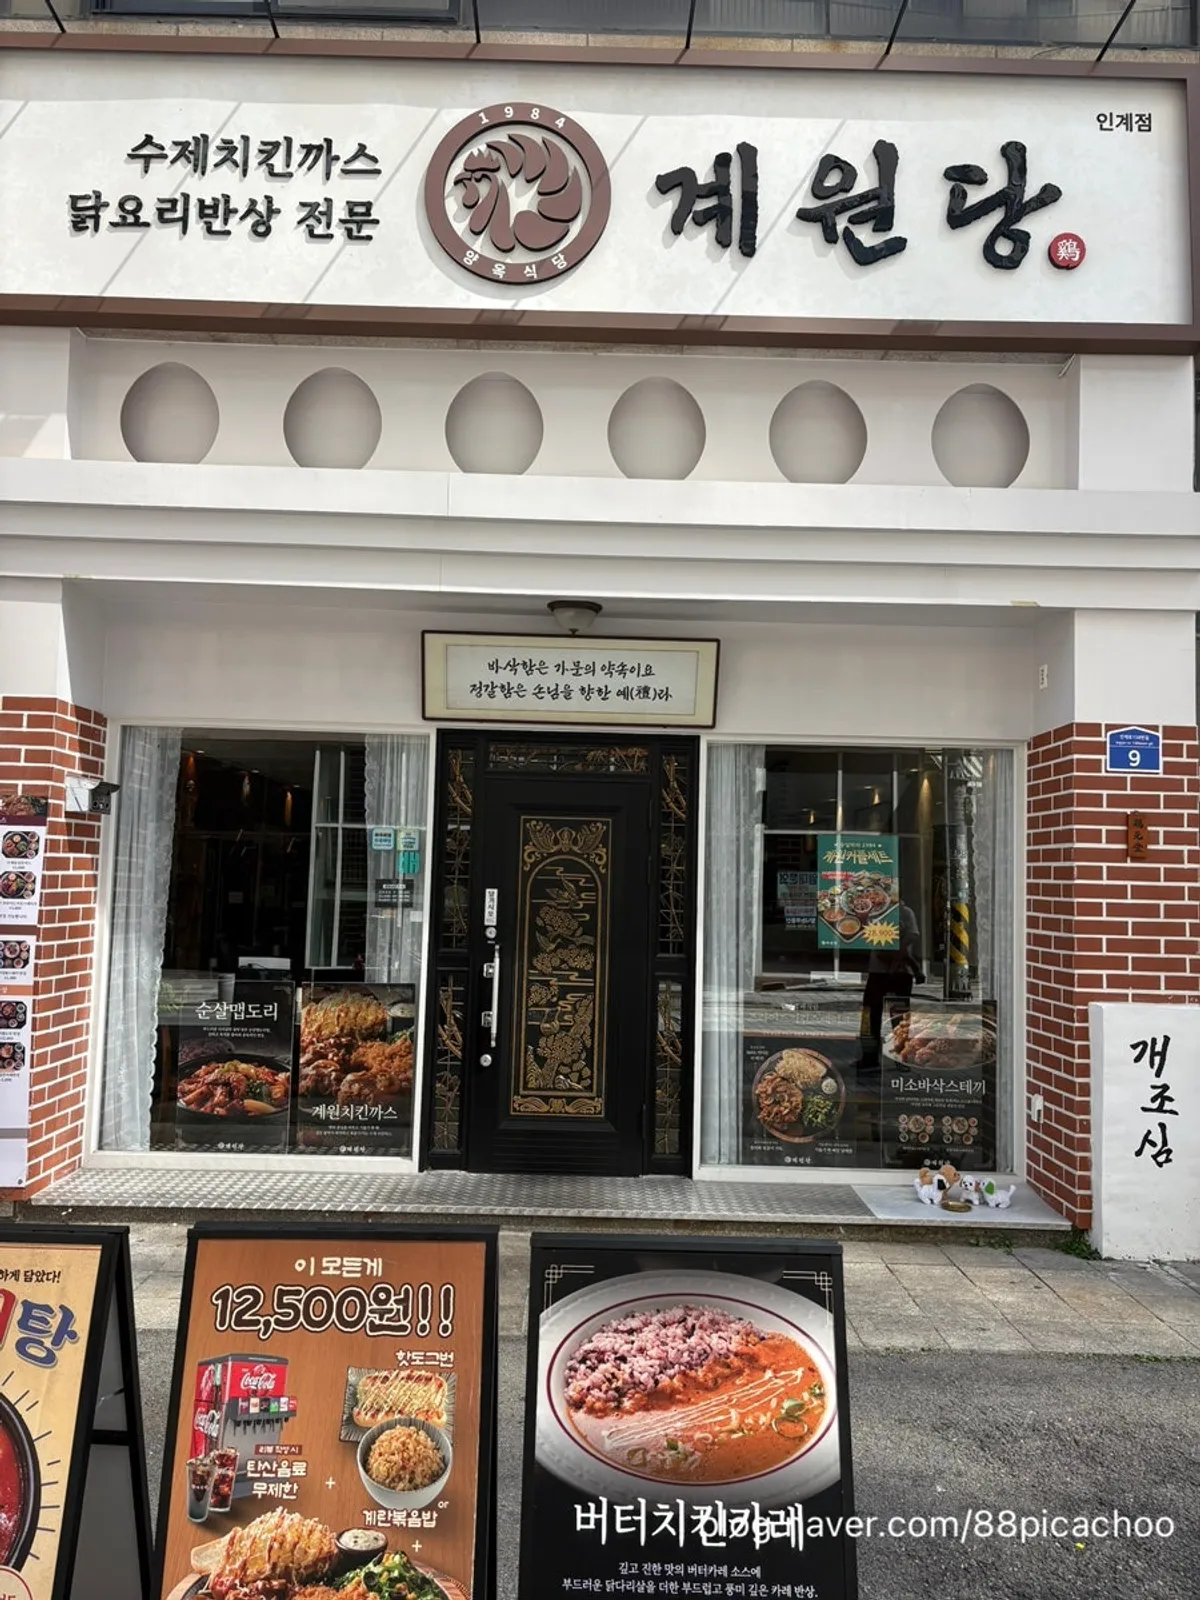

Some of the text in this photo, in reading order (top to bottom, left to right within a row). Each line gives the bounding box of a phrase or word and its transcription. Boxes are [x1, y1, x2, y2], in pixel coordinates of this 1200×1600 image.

[477, 105, 567, 129] 1984
[1096, 111, 1153, 133] 인계점
[127, 133, 382, 180] 수제치킨까스
[655, 139, 1062, 270] 계원당
[69, 190, 380, 241] 닭요리반상 전문
[487, 658, 655, 678] 바삭함은 가문의 약속이요
[469, 682, 527, 699] 정갈함은
[532, 683, 574, 700] 손님을
[579, 685, 611, 701] 향한
[1128, 749, 1141, 767] 9
[195, 1001, 279, 1022] 순살맵도리
[890, 1077, 987, 1096] 미소바삭스테끼
[1130, 1035, 1179, 1168] 개조심
[311, 1104, 398, 1122] 계원치킨까스
[23, 1269, 62, 1284] 담았다!
[295, 1256, 383, 1278] 이 모든게
[211, 1283, 456, 1340] 12,500원!!
[395, 1349, 455, 1368] 핫도그번
[246, 1460, 308, 1478] 탄산음료
[252, 1481, 299, 1500] 무제한
[437, 1500, 449, 1509] or
[362, 1508, 438, 1528] 계란볶음밥
[618, 1561, 762, 1580] 깊고 진한 맛의 버터카레 소스에
[562, 1578, 819, 1599] 부드러운 닭다리살을 더한 부드럽고 풍미 깊은 카레 반상.
